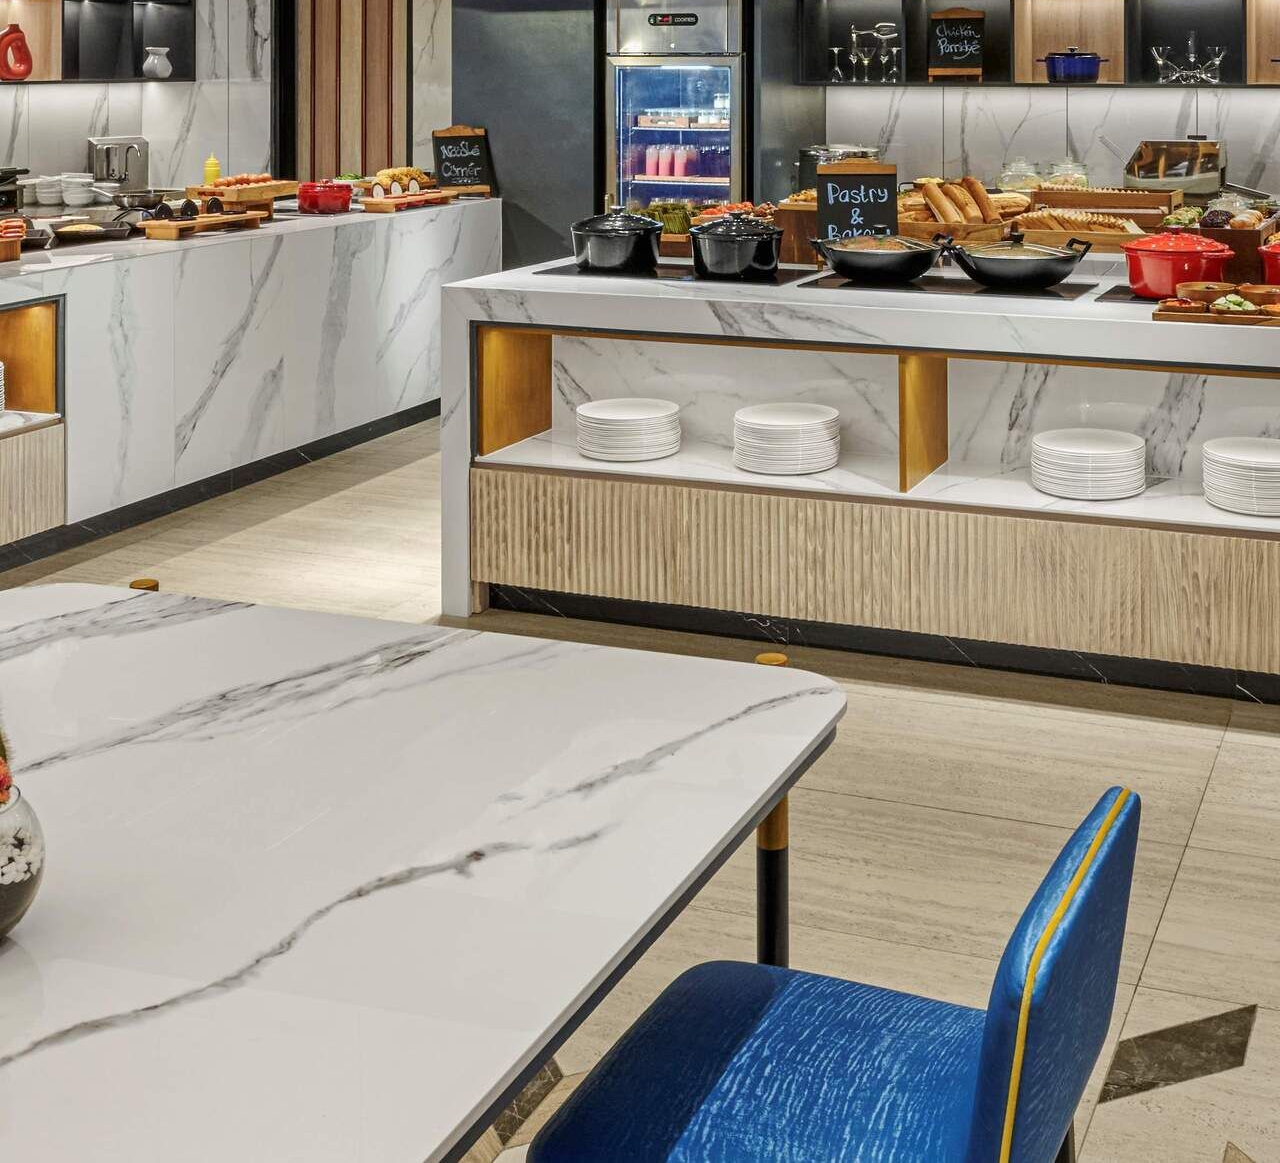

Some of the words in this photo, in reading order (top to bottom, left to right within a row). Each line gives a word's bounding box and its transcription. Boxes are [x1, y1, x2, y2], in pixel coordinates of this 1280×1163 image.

[935, 20, 981, 38] Chicken
[937, 38, 981, 60] Porridge
[827, 182, 889, 205] Pastry
[850, 207, 864, 225] &
